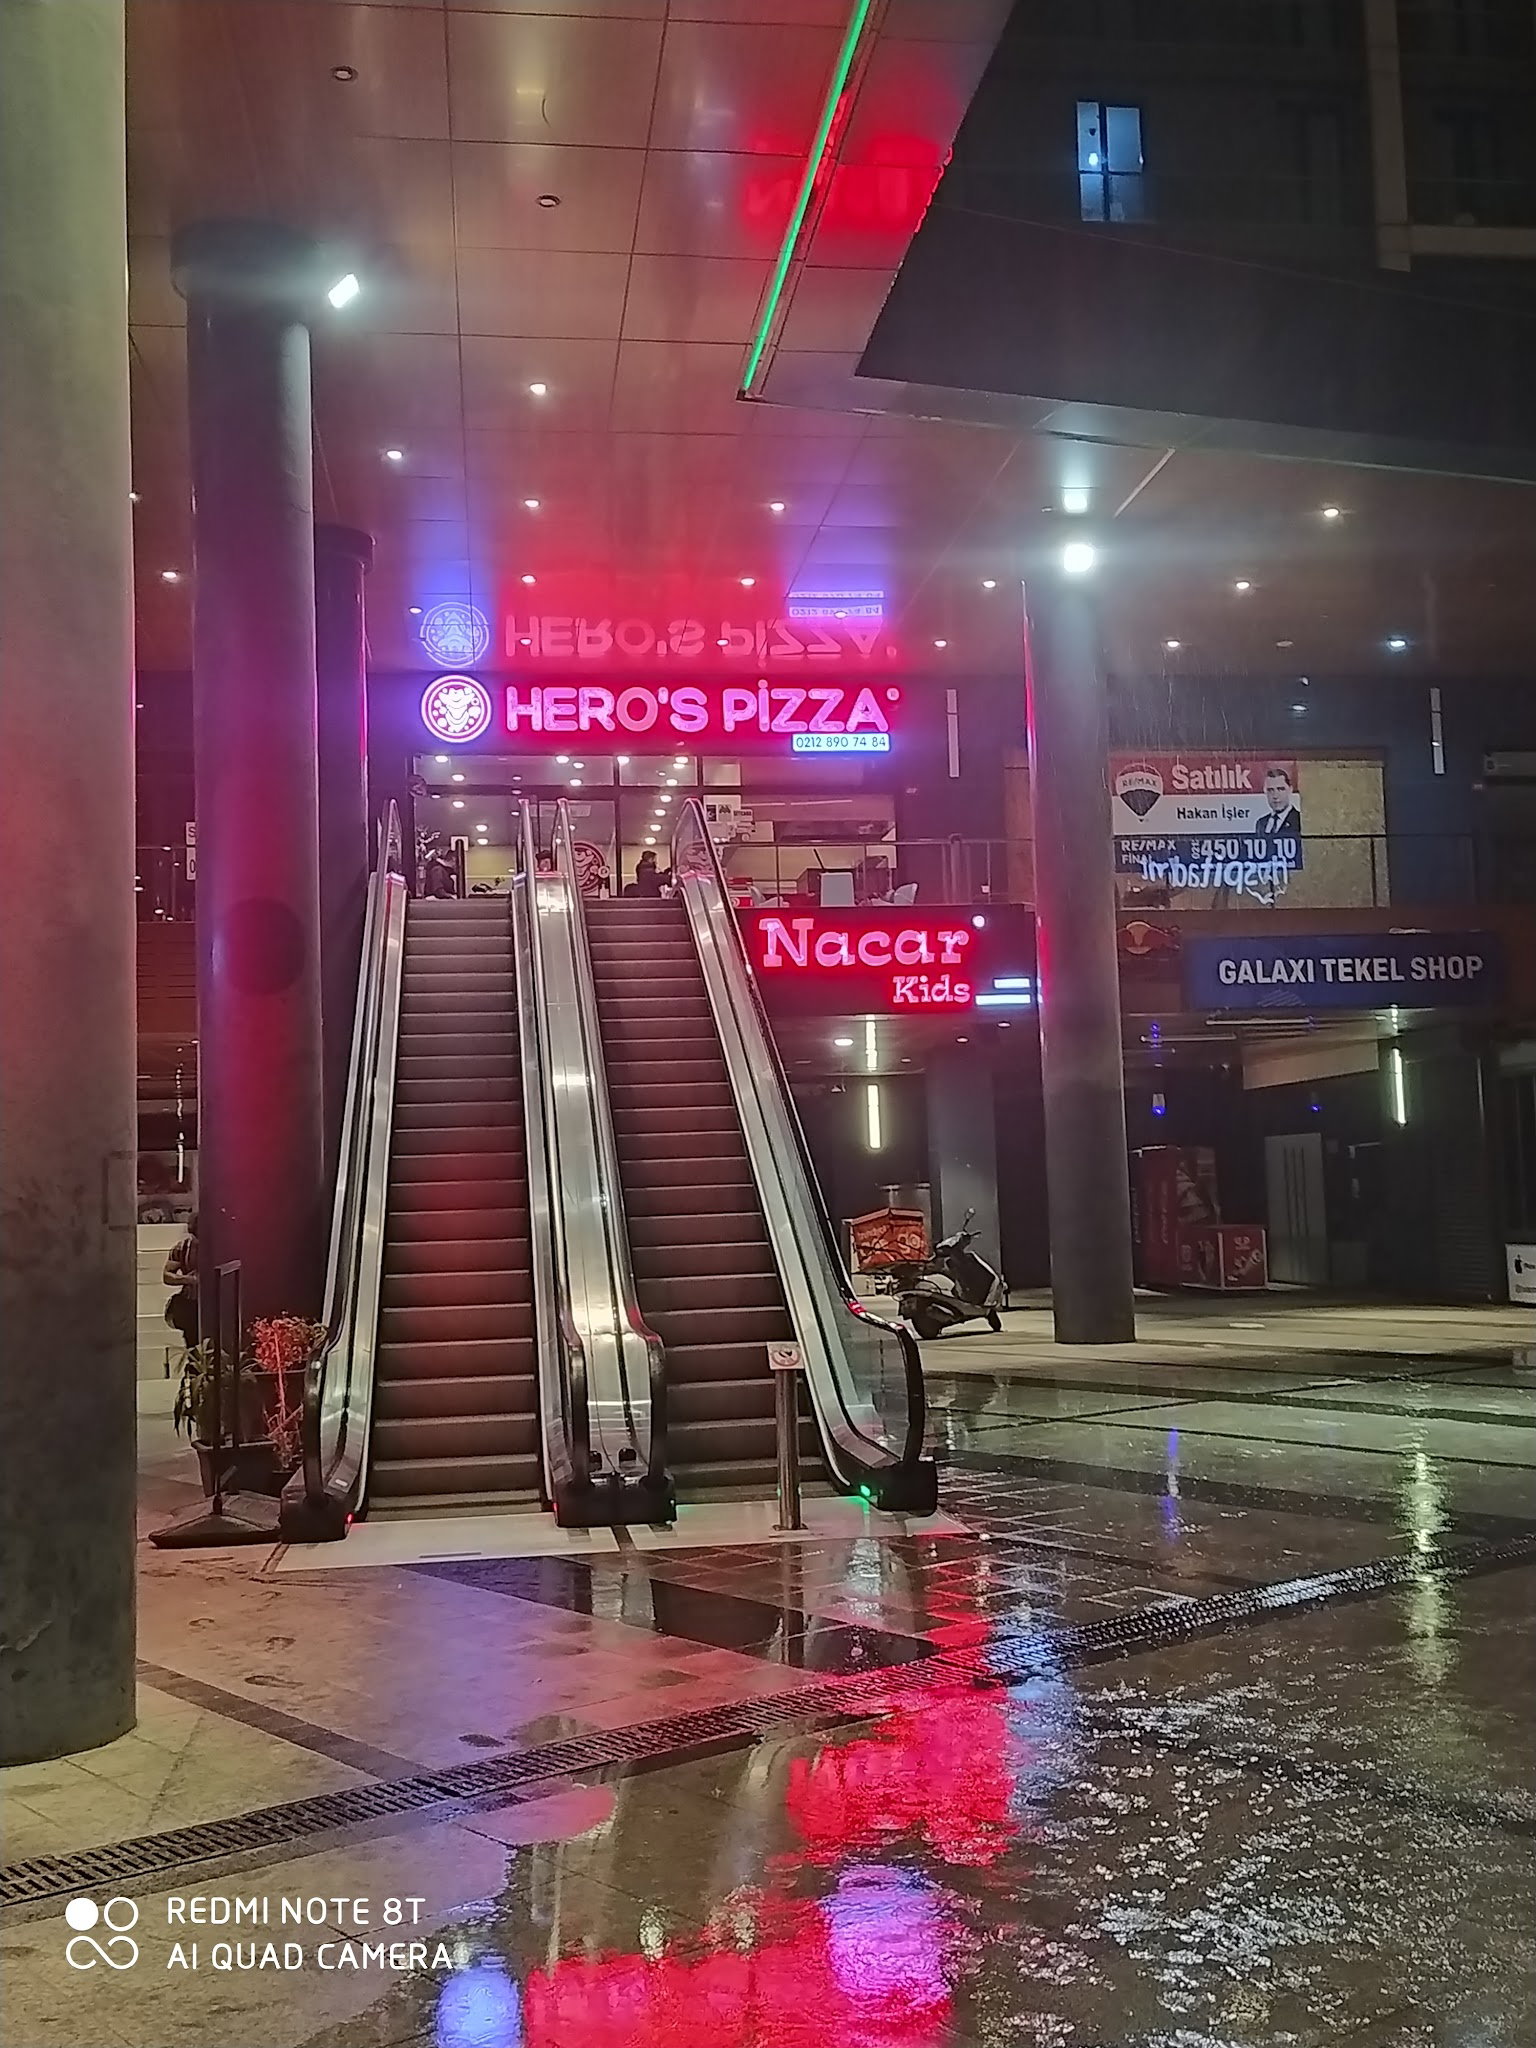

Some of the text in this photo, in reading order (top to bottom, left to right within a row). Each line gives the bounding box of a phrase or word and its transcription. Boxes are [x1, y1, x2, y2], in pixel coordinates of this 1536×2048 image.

[506, 686, 709, 732] HERO'S
[796, 736, 886, 748] 0212 890 74 84
[1122, 777, 1158, 787] RE/MAX
[1172, 763, 1252, 790] Satılık
[1177, 803, 1250, 821] Hakan İşler
[1121, 839, 1177, 852] RE/MAX
[1201, 838, 1296, 861] 450 10 10
[758, 917, 970, 968] Nacar
[1219, 955, 1484, 984] GALAXI TEKEL SHOP
[892, 974, 970, 1004] Kids
